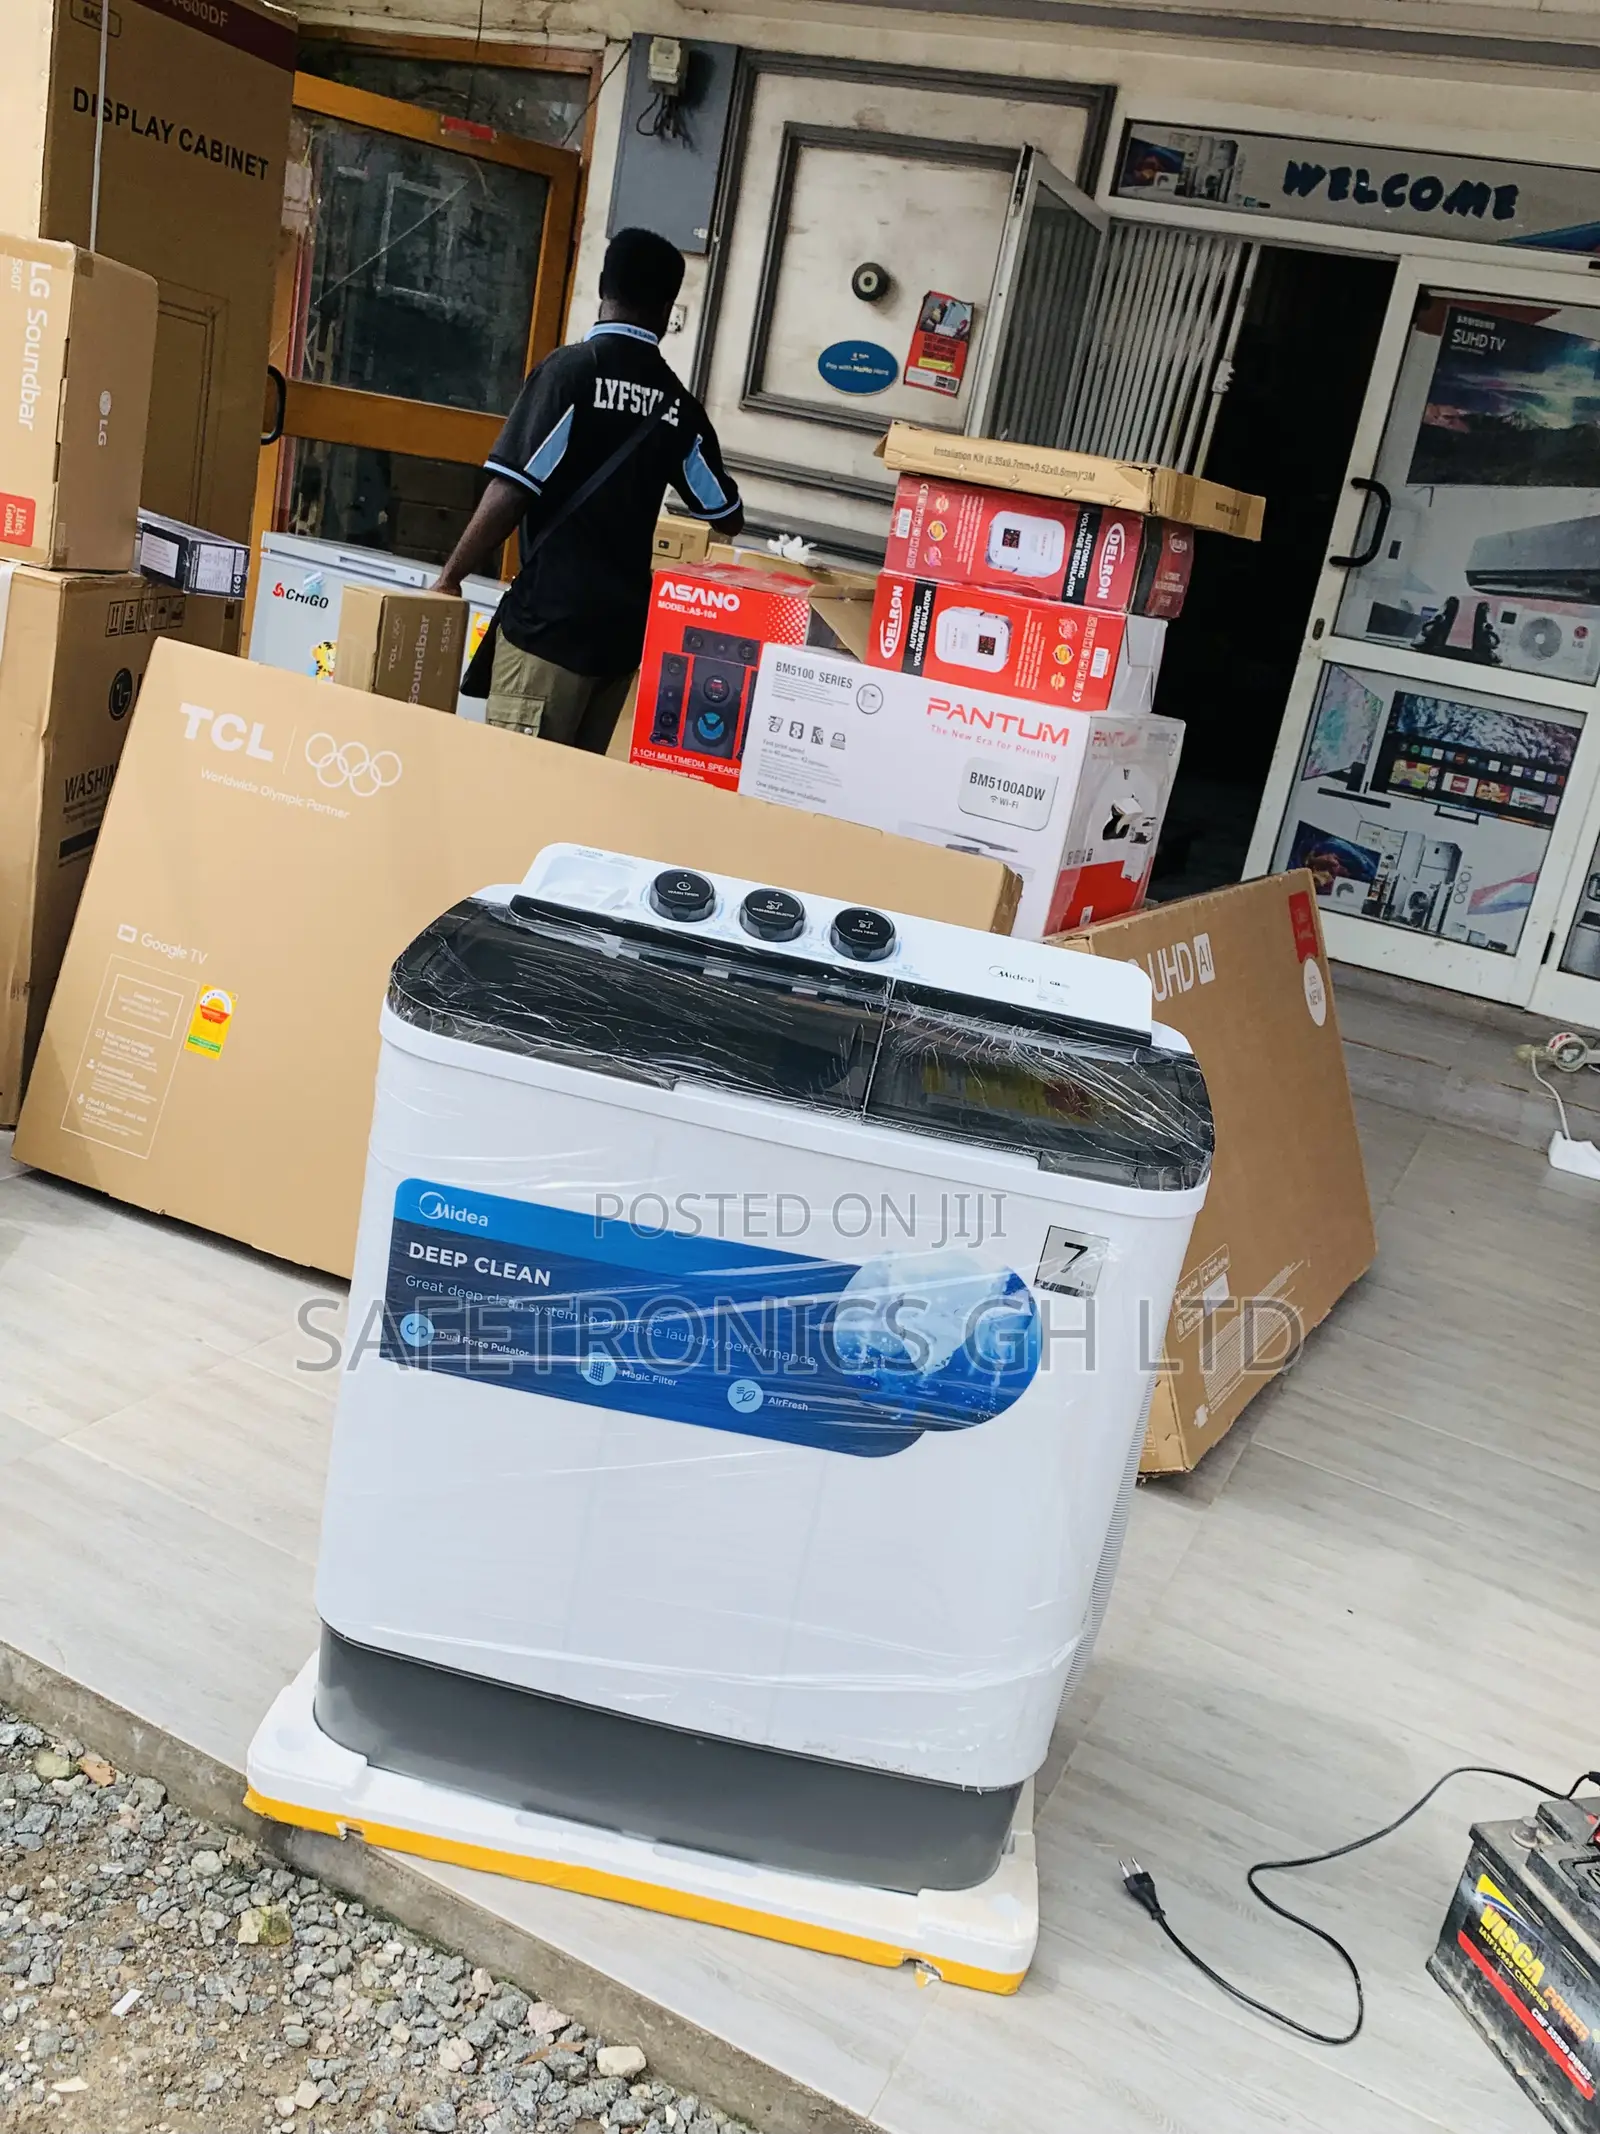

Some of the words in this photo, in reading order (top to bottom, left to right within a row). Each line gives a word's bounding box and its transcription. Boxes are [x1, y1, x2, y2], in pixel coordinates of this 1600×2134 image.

[73, 87, 175, 144] DISPLAY
[178, 128, 269, 180] CABINET
[1282, 160, 1520, 220] WELCOME
[29, 261, 52, 299] LG
[1452, 329, 1488, 347] SUHD
[1490, 336, 1506, 351] TV
[18, 308, 47, 431] Soundbar
[98, 419, 108, 446] LG
[933, 446, 972, 461] Installation
[973, 455, 984, 464] Kit
[15, 507, 27, 536] Life's
[1074, 512, 1090, 549] VOLTAGE
[1066, 548, 1083, 598] REGULATOR
[1078, 532, 1093, 579] AUTOMATIC
[1097, 529, 1121, 600] DELRON
[286, 587, 329, 610] CHIGO
[659, 580, 741, 612] ASANO
[884, 584, 904, 650] DELRON
[908, 605, 922, 650] AUTOMATIC
[388, 645, 398, 672] TCL
[913, 632, 926, 667] VOLTAGE
[775, 661, 815, 681] BM5100
[818, 672, 854, 689] SERIES
[179, 702, 274, 763] TCL
[926, 697, 1070, 747] PANTUM
[633, 748, 656, 760] 3.1CH
[657, 752, 706, 769] MULTIMEDIA
[930, 724, 949, 736] The
[951, 729, 972, 742] New
[976, 735, 993, 747] Era
[996, 740, 1012, 751] for
[1015, 744, 1057, 763] Printing
[201, 766, 259, 795] Worldwide
[260, 785, 304, 807] Olympic
[306, 798, 351, 819] Partner
[969, 771, 1047, 801] BM5100ADW
[999, 796, 1020, 810] Wi-Fi
[141, 932, 187, 963] Google
[189, 948, 209, 965] TV
[991, 967, 1034, 983] Midea
[1147, 942, 1195, 1002] UHD
[1200, 943, 1213, 975] AI
[422, 1193, 489, 1227] Midea
[409, 1241, 468, 1268] DEEP
[474, 1256, 551, 1287] CLEAN
[1060, 1241, 1088, 1273] 7
[405, 1274, 443, 1294] Great
[447, 1285, 483, 1303] deep
[487, 1293, 524, 1311] clean
[528, 1303, 579, 1322] system
[584, 1311, 598, 1324] to
[667, 1327, 720, 1349] laundry
[724, 1341, 819, 1367] performance.
[439, 1331, 461, 1344] Dual
[462, 1336, 489, 1349] Force
[491, 1342, 530, 1357] Pulsator
[621, 1369, 650, 1383] Magic
[652, 1374, 678, 1387] Filter
[768, 1396, 809, 1411] AirFresh
[1480, 1903, 1546, 1987] VISCA
[1514, 1967, 1550, 2011] CERTIFIED
[1543, 1985, 1591, 2043] POWER
